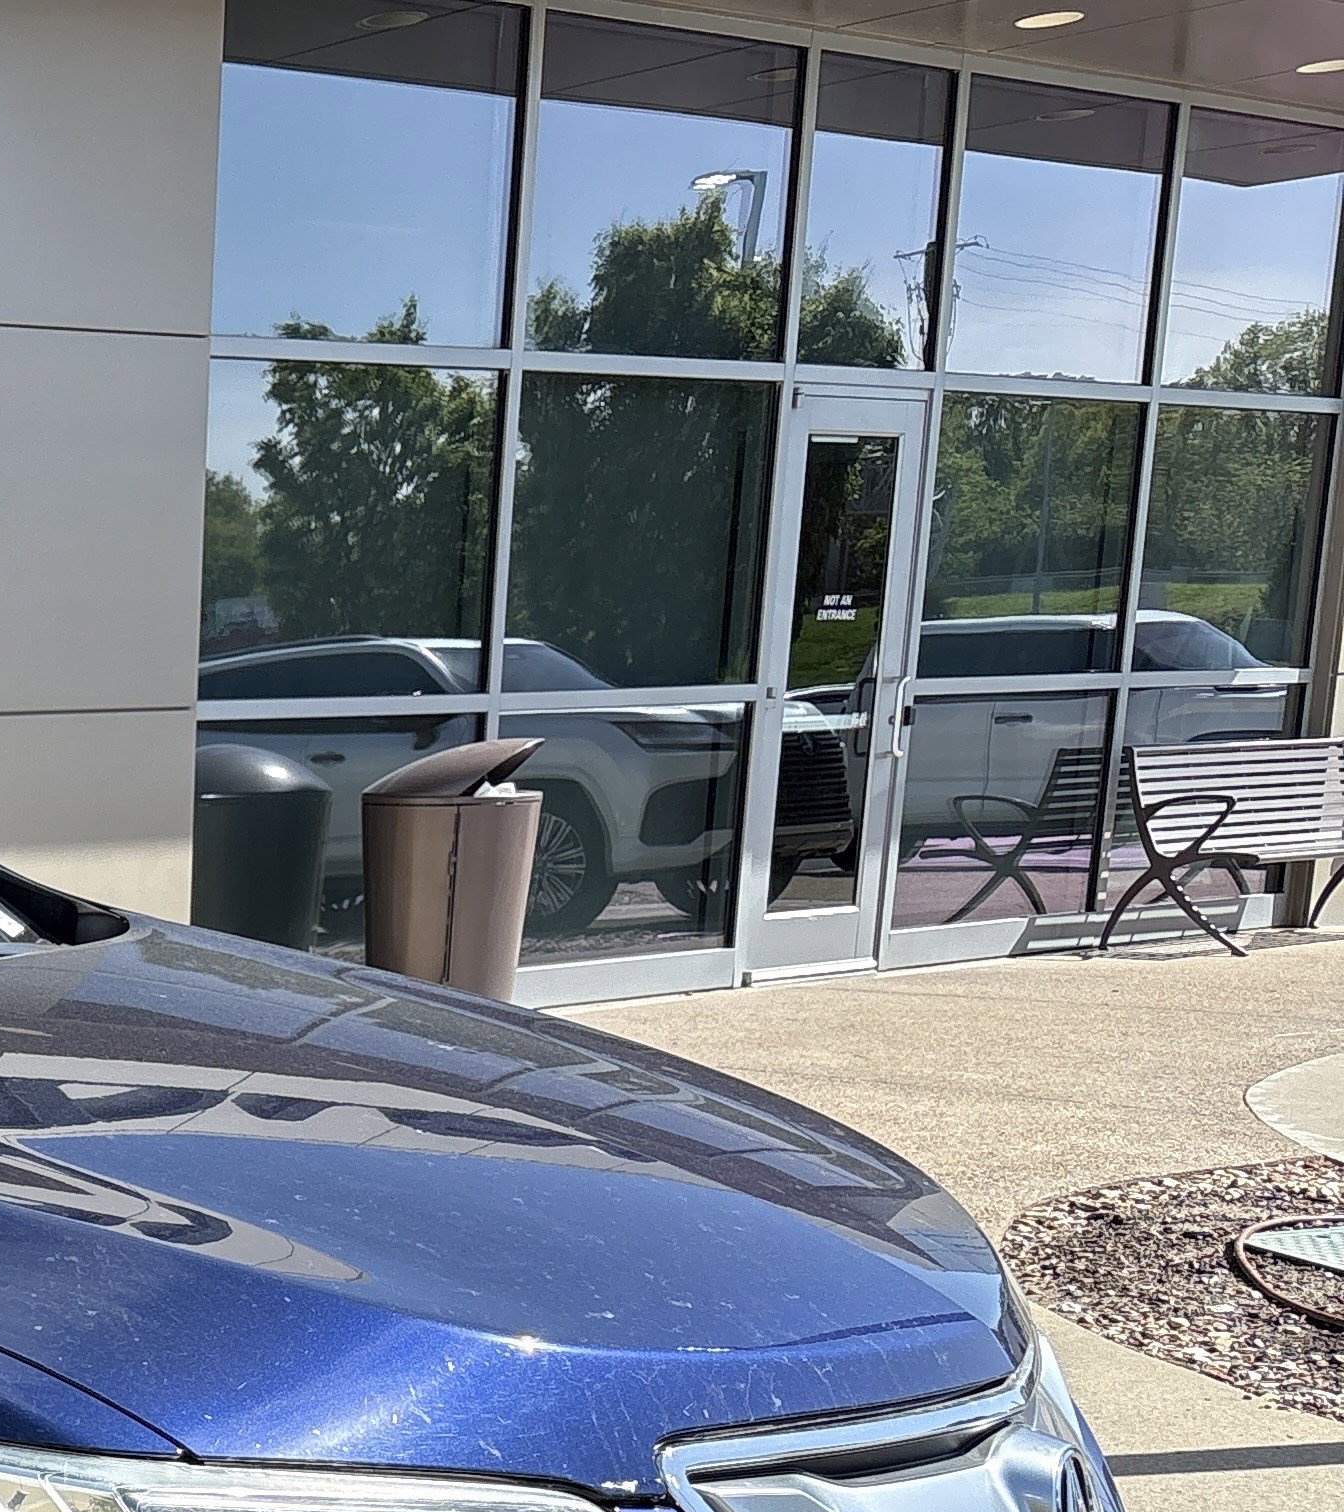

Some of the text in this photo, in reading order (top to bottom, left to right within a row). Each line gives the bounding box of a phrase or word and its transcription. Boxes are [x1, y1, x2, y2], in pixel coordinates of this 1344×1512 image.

[823, 594, 853, 606] NOT AN
[816, 609, 857, 621] ENTRANCE
